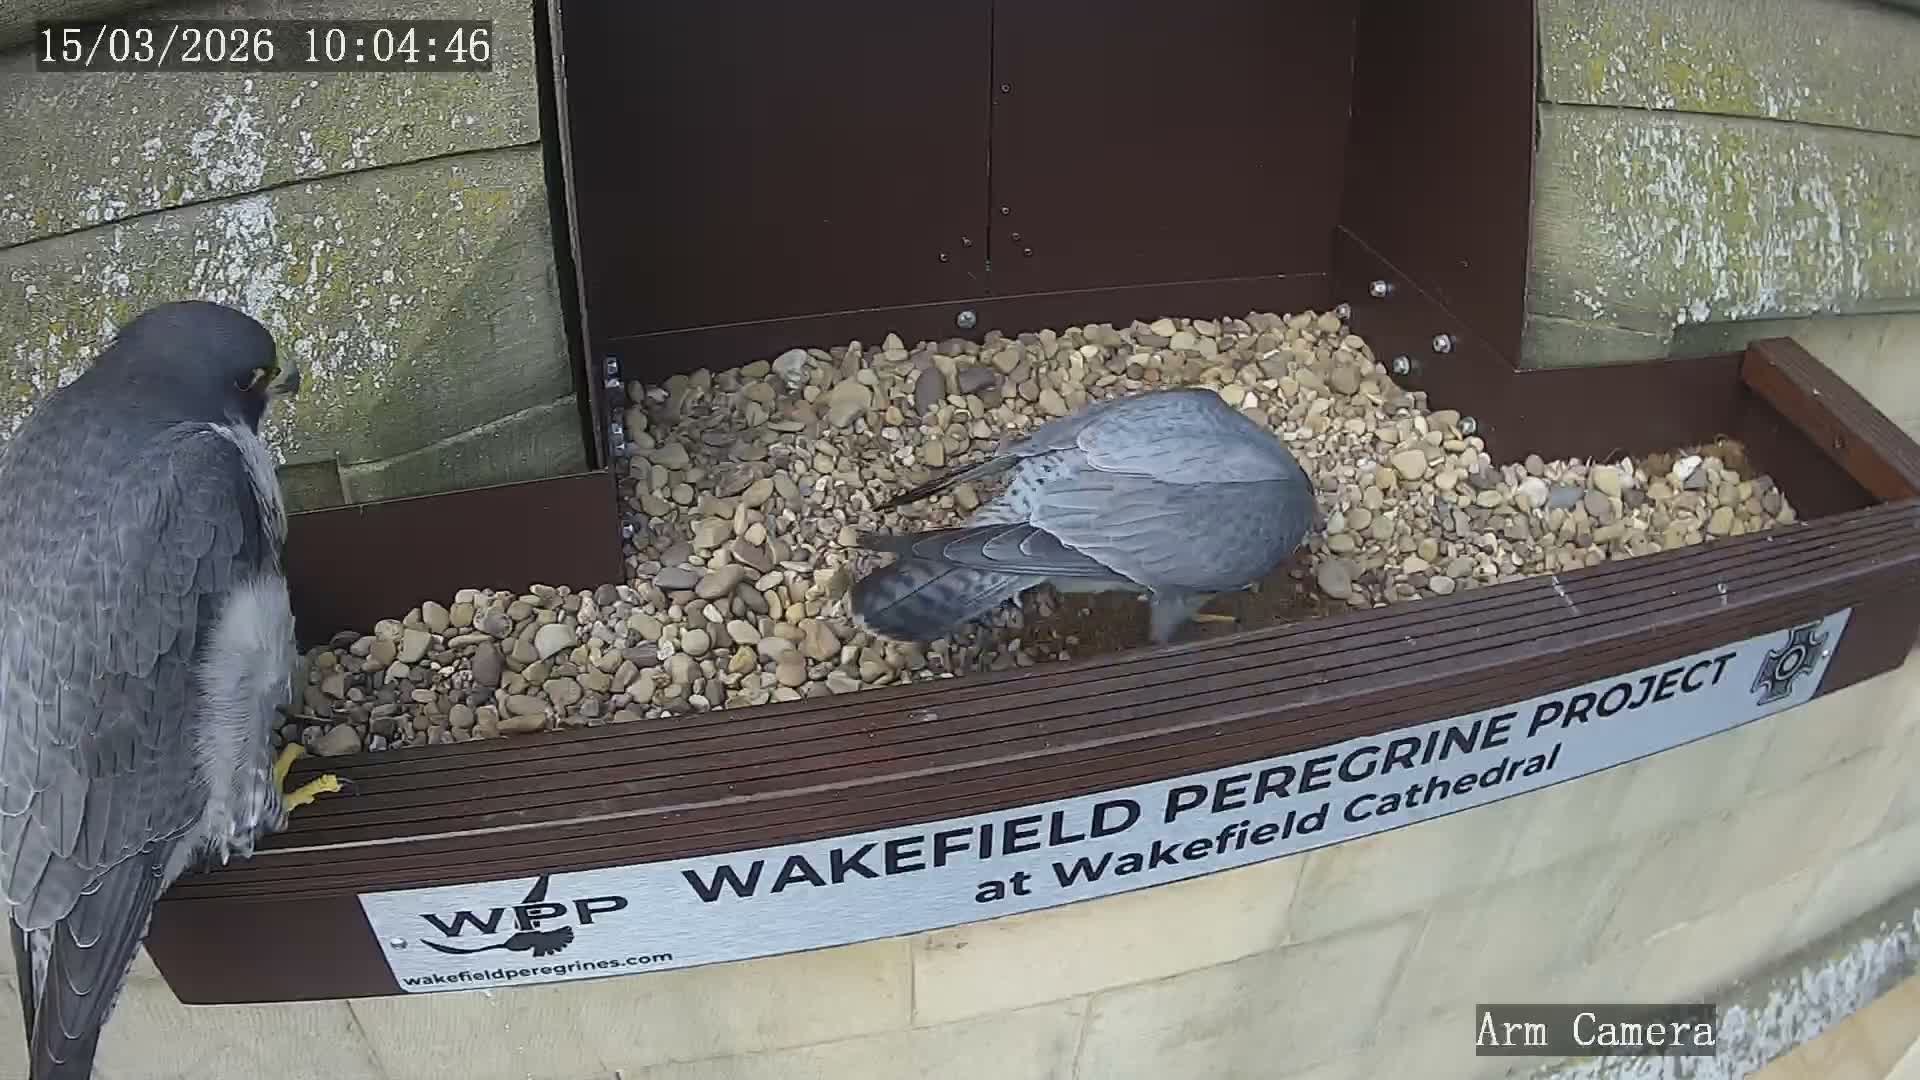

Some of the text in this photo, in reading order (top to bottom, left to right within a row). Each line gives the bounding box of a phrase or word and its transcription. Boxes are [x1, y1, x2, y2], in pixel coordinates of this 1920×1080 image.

[681, 652, 1737, 904] WAKEFIELD PEREGRINE PROJECT
[974, 744, 1562, 904] at Wakefield Cathedral
[418, 895, 629, 938] WPP
[402, 951, 673, 987] wakefieldperegrines.com
